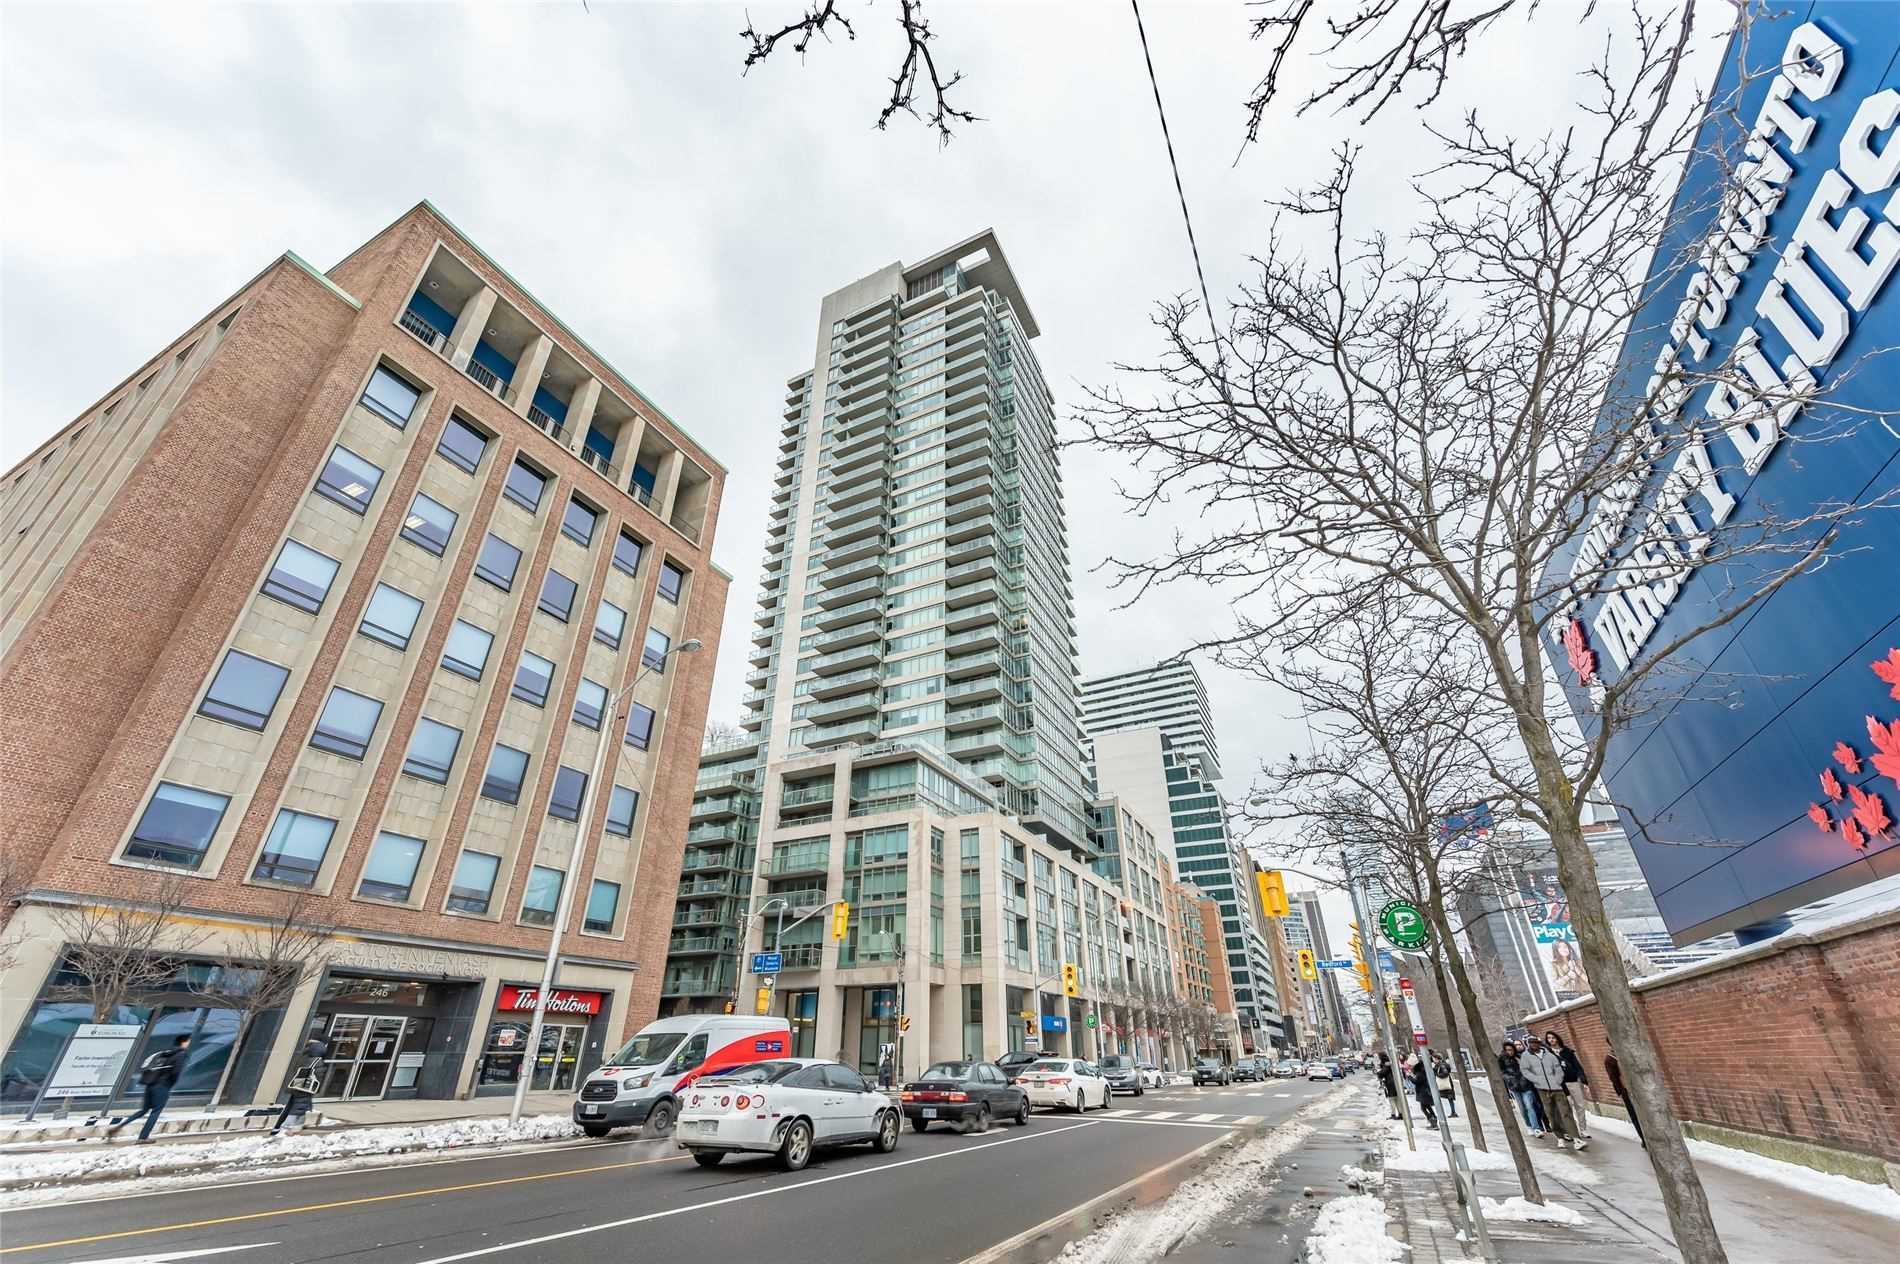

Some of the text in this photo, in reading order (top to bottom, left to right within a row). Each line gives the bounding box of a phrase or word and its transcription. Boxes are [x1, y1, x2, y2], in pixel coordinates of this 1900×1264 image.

[1670, 22, 1845, 363] TORONTO
[1593, 428, 1737, 673] VARSITY
[1394, 911, 1417, 933] P
[370, 987, 388, 998] 246
[546, 990, 591, 1013] Hortons
